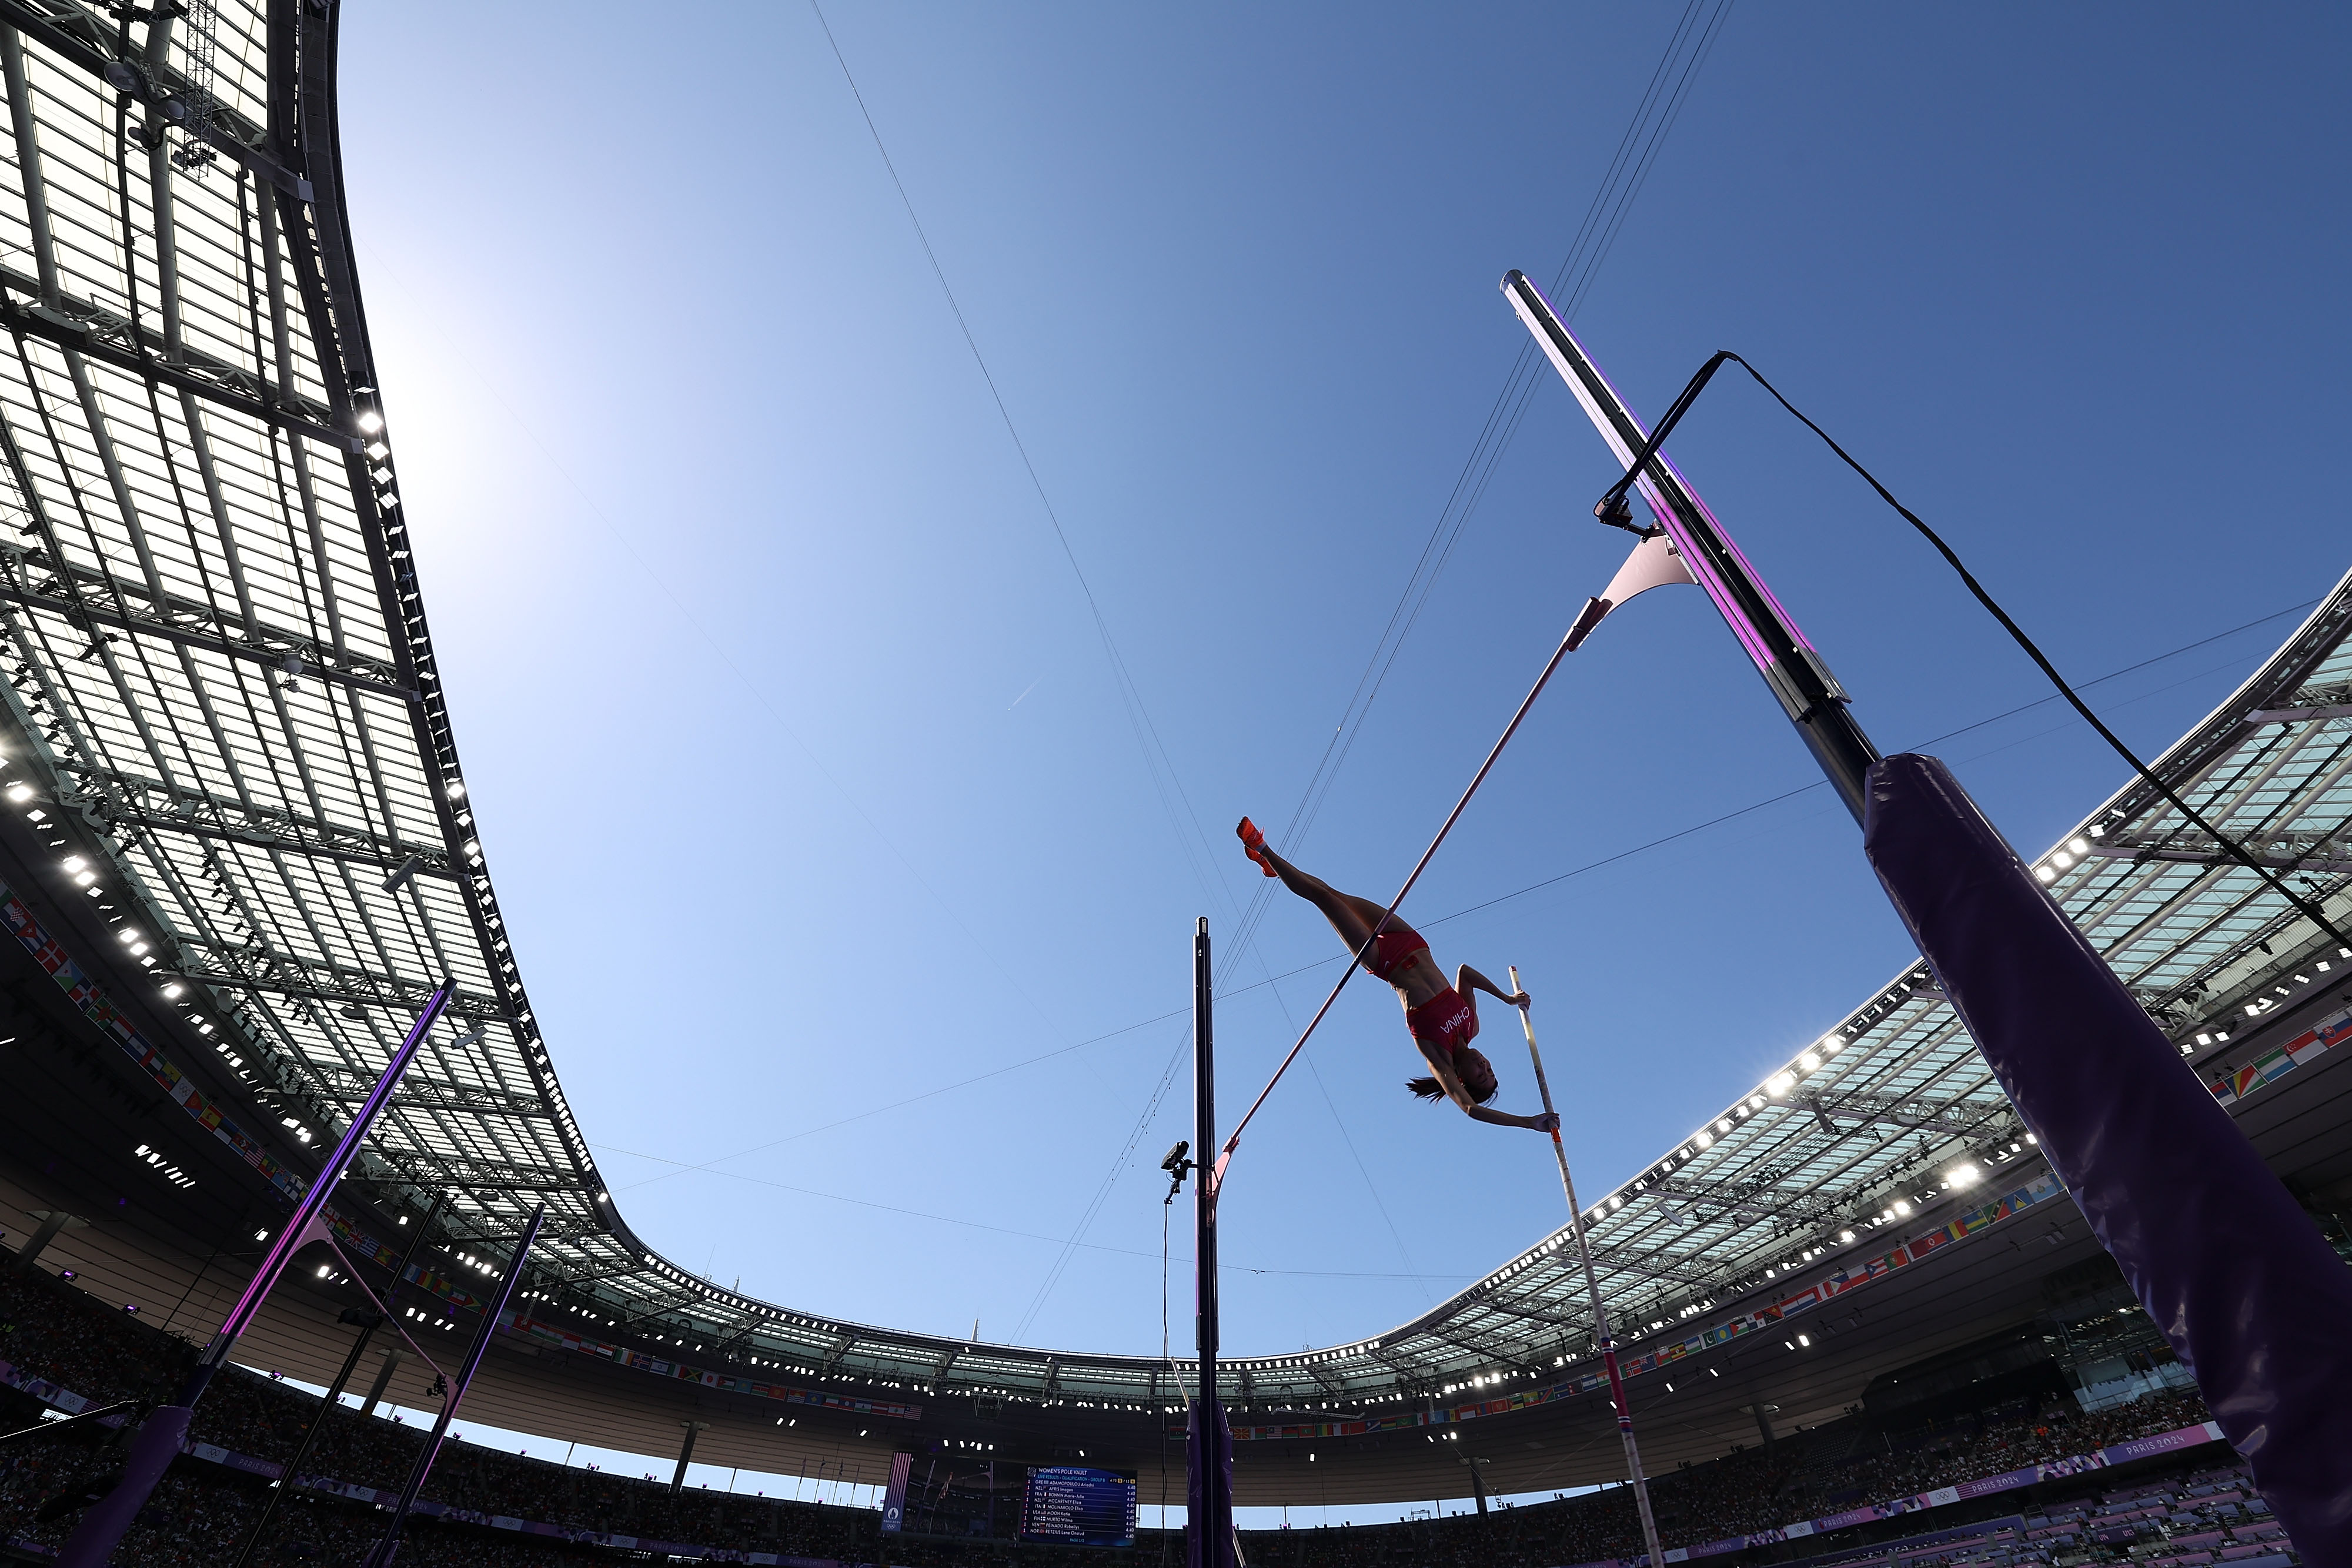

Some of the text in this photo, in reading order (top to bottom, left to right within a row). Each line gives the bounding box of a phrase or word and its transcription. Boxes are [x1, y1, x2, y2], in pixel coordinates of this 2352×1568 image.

[1440, 1007, 1469, 1034] CHINA
[2126, 1435, 2184, 1455] PARIS 2024
[239, 1458, 278, 1475] PARIS 2024
[1972, 1476, 2019, 1493] PARIS 2024
[1823, 1513, 1861, 1527] PARIS 2024
